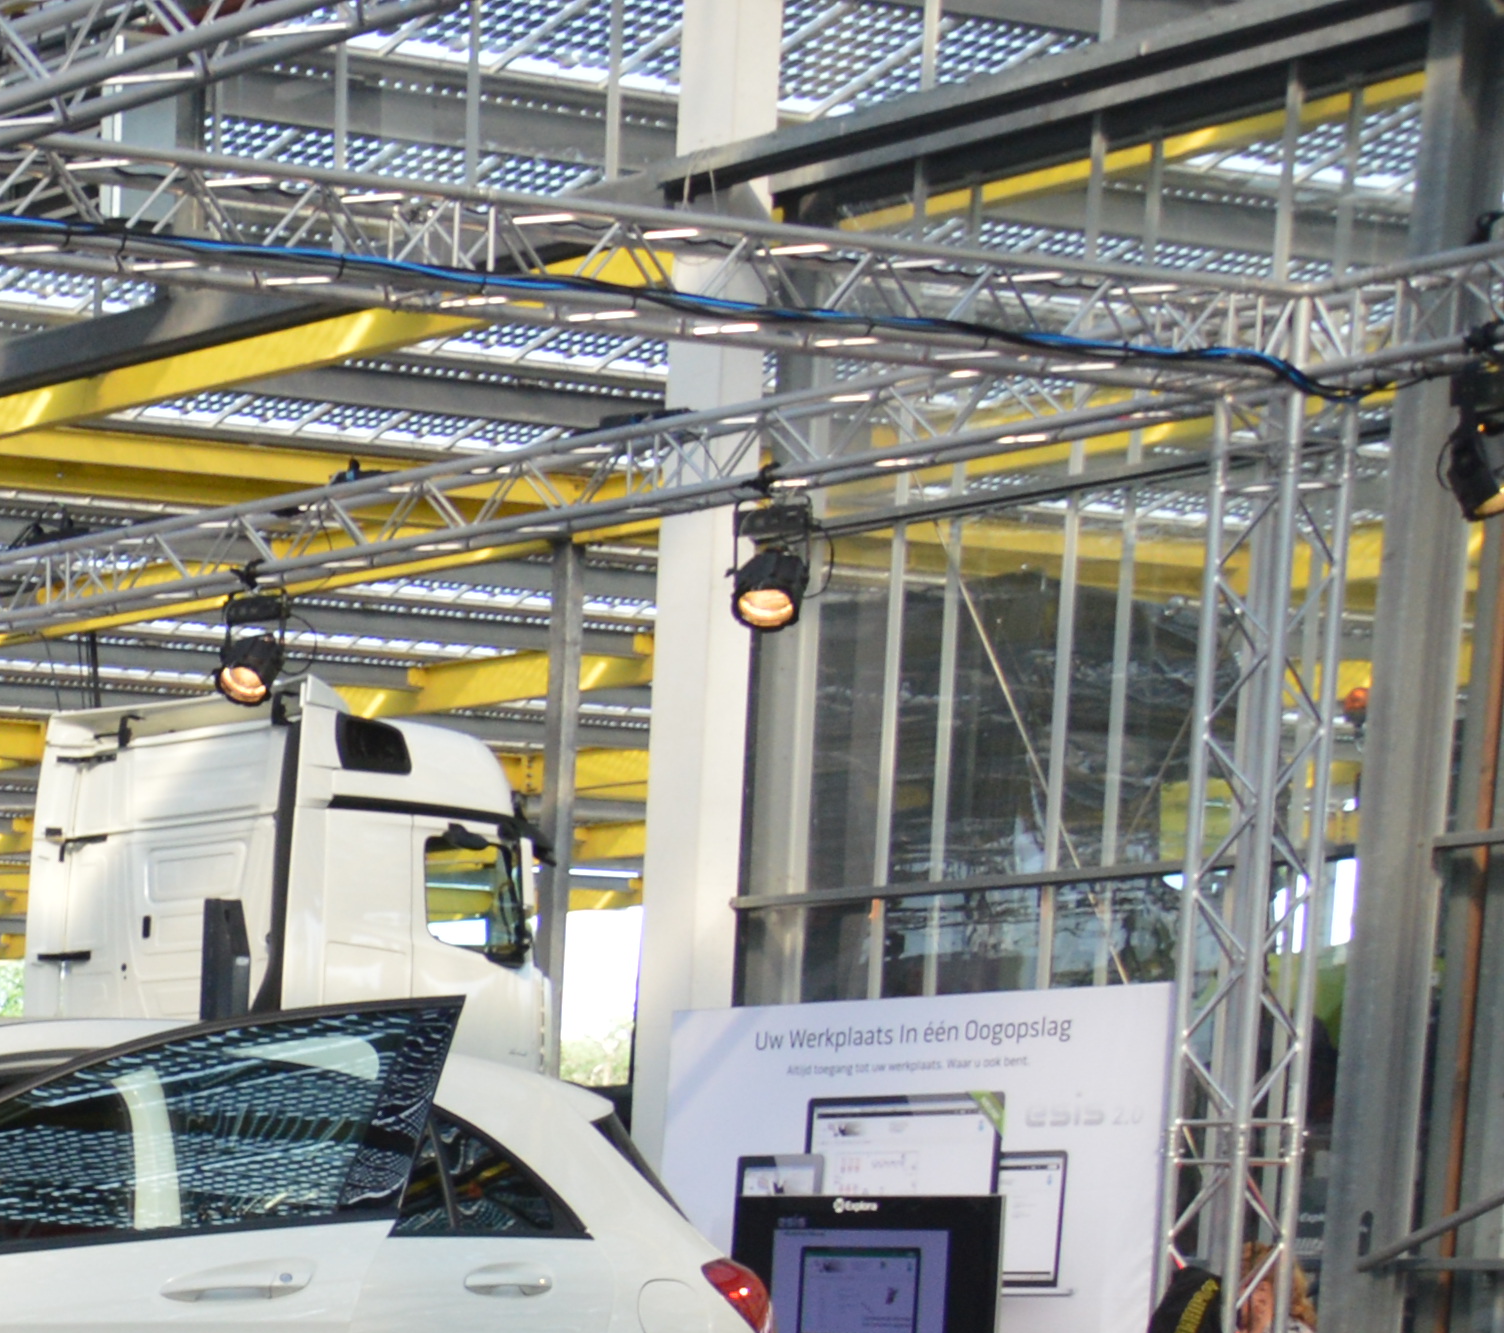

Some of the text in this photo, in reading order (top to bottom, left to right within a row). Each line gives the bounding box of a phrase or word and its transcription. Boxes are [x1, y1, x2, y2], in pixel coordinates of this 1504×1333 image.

[755, 1015, 1073, 1053] Uw Werkplaats In één Oogopslag
